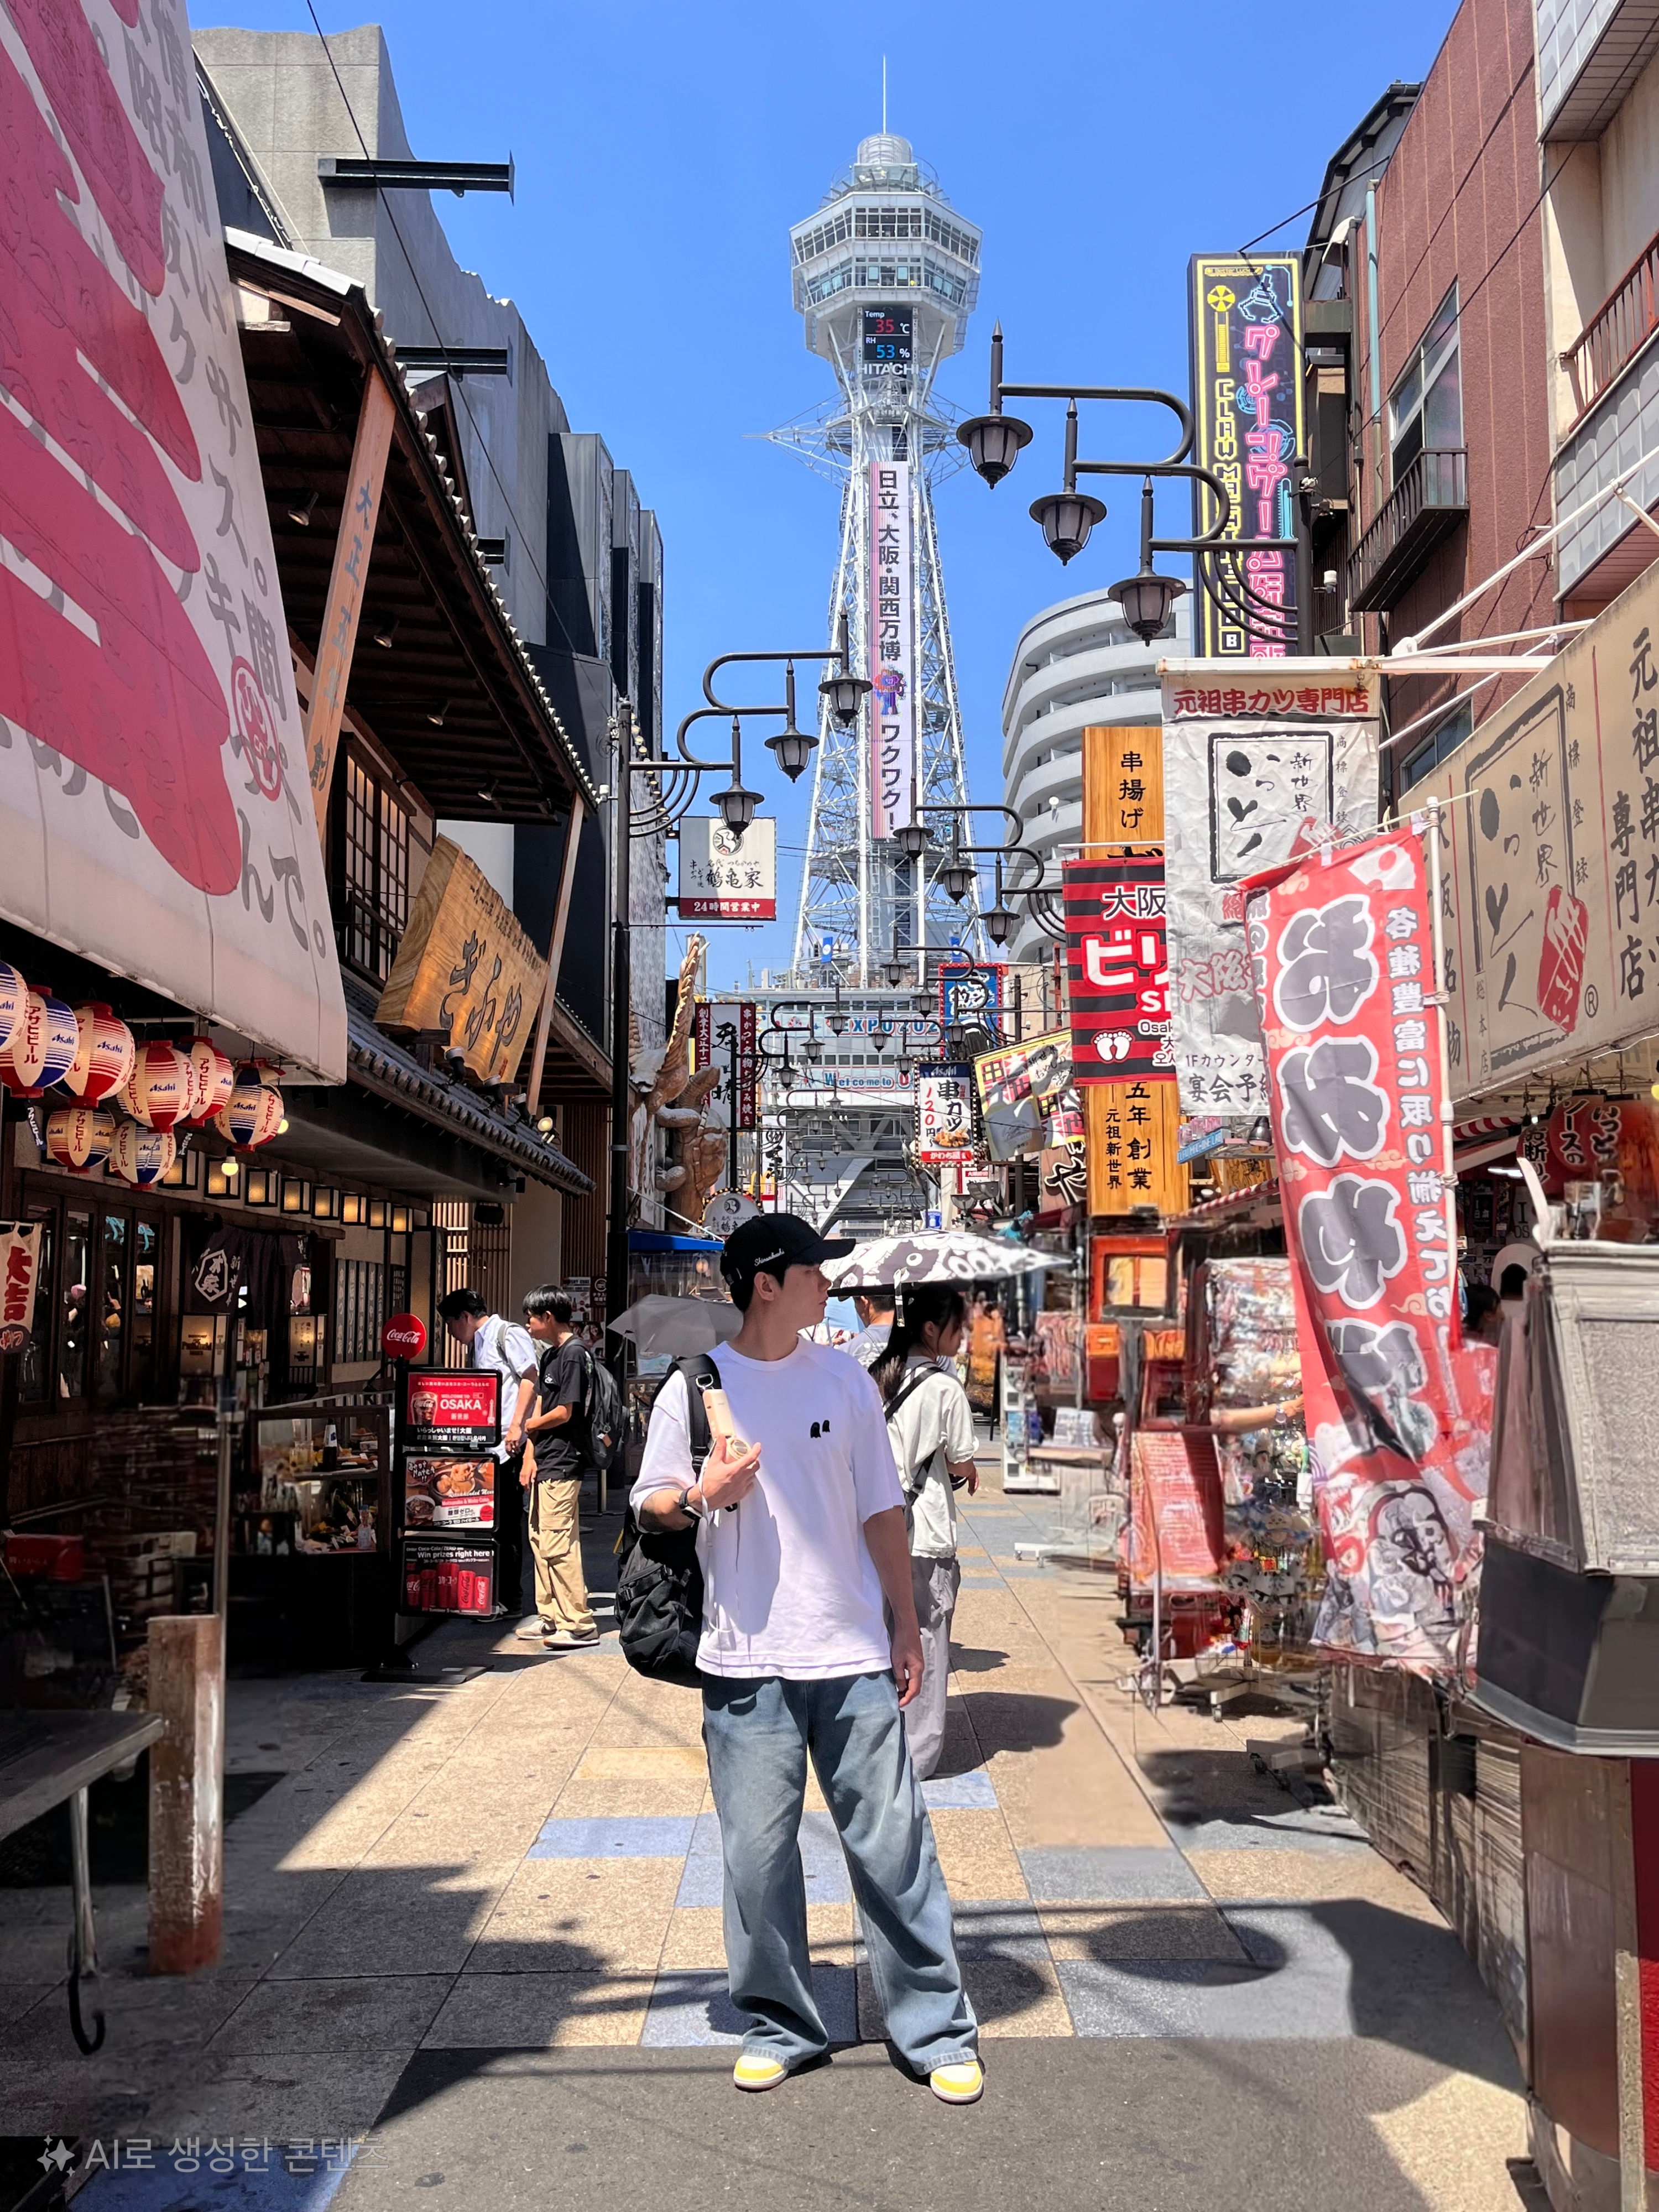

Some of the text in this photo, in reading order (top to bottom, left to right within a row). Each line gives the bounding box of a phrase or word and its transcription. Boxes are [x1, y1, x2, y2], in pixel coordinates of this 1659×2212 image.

[865, 310, 885, 319] Temp
[875, 319, 895, 333] 35
[877, 345, 910, 359] 53 %
[858, 363, 919, 376] HITACHI
[1173, 687, 1370, 715] 元祖串カツ専門店
[1118, 750, 1147, 829] 串揚げ
[1290, 752, 1317, 812] 新世界
[1528, 749, 1559, 889] 新世界
[706, 867, 764, 889] 鶴亀家
[1611, 790, 1646, 1001] 専門店
[693, 901, 761, 912] 24時間営業中
[24, 1006, 41, 1064] アサヒビール
[52, 1033, 75, 1045] Asahi
[97, 1041, 123, 1054] Asahi
[931, 1065, 957, 1076] Asahi
[149, 1083, 176, 1092] Asahi
[182, 1062, 194, 1111] アサヒビール
[195, 1058, 210, 1105] アサヒビール
[882, 1076, 892, 1086] to
[233, 1102, 256, 1112] Asahi
[937, 1079, 963, 1132] 串カツ
[74, 1112, 86, 1152] アサヒビール
[119, 1126, 129, 1168] アサヒビール
[1105, 1108, 1123, 1190] 元祖新世界
[1515, 1225, 1532, 1239] OS
[386, 1328, 422, 1344] Coca-Cola
[440, 1399, 482, 1411] OSAKA
